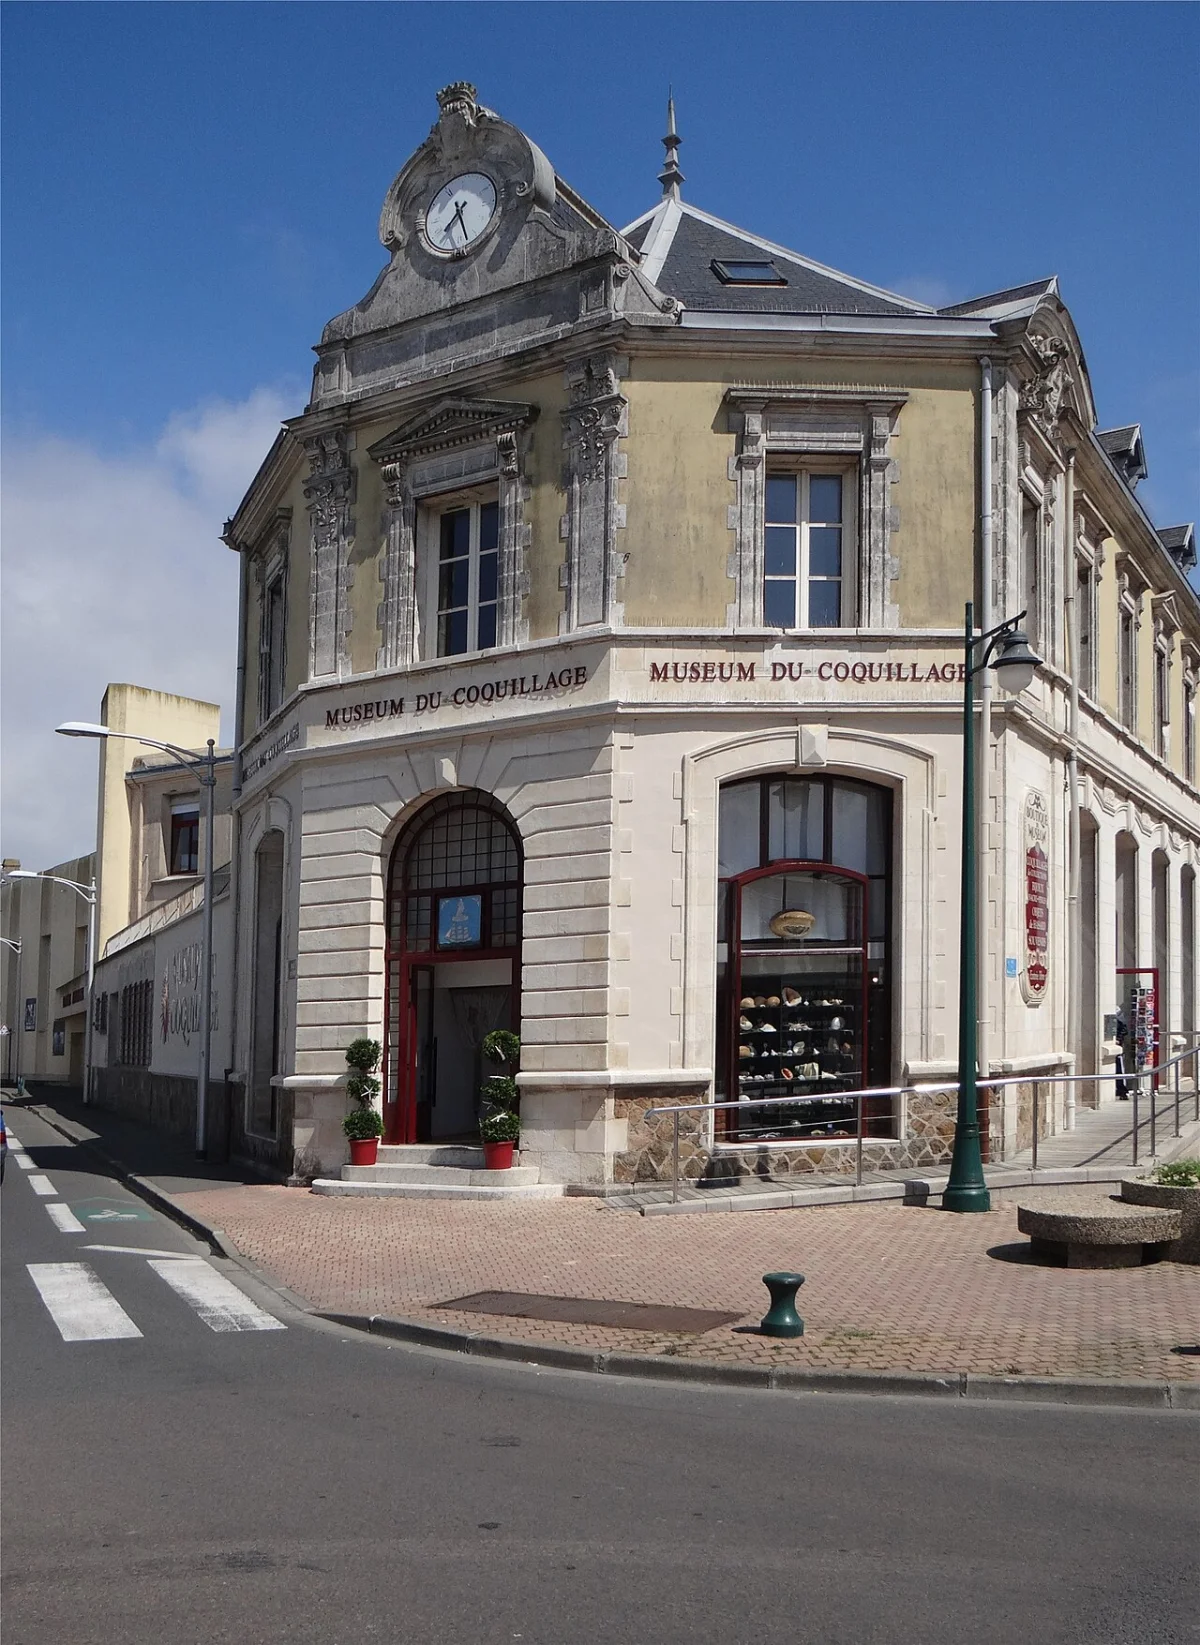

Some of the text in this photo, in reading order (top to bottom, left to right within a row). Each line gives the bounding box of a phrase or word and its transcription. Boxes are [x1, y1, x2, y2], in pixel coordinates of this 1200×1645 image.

[650, 662, 756, 682] MUSEUM
[771, 662, 803, 682] DU
[326, 666, 587, 727] MUSEUM DU COQUILLAGE
